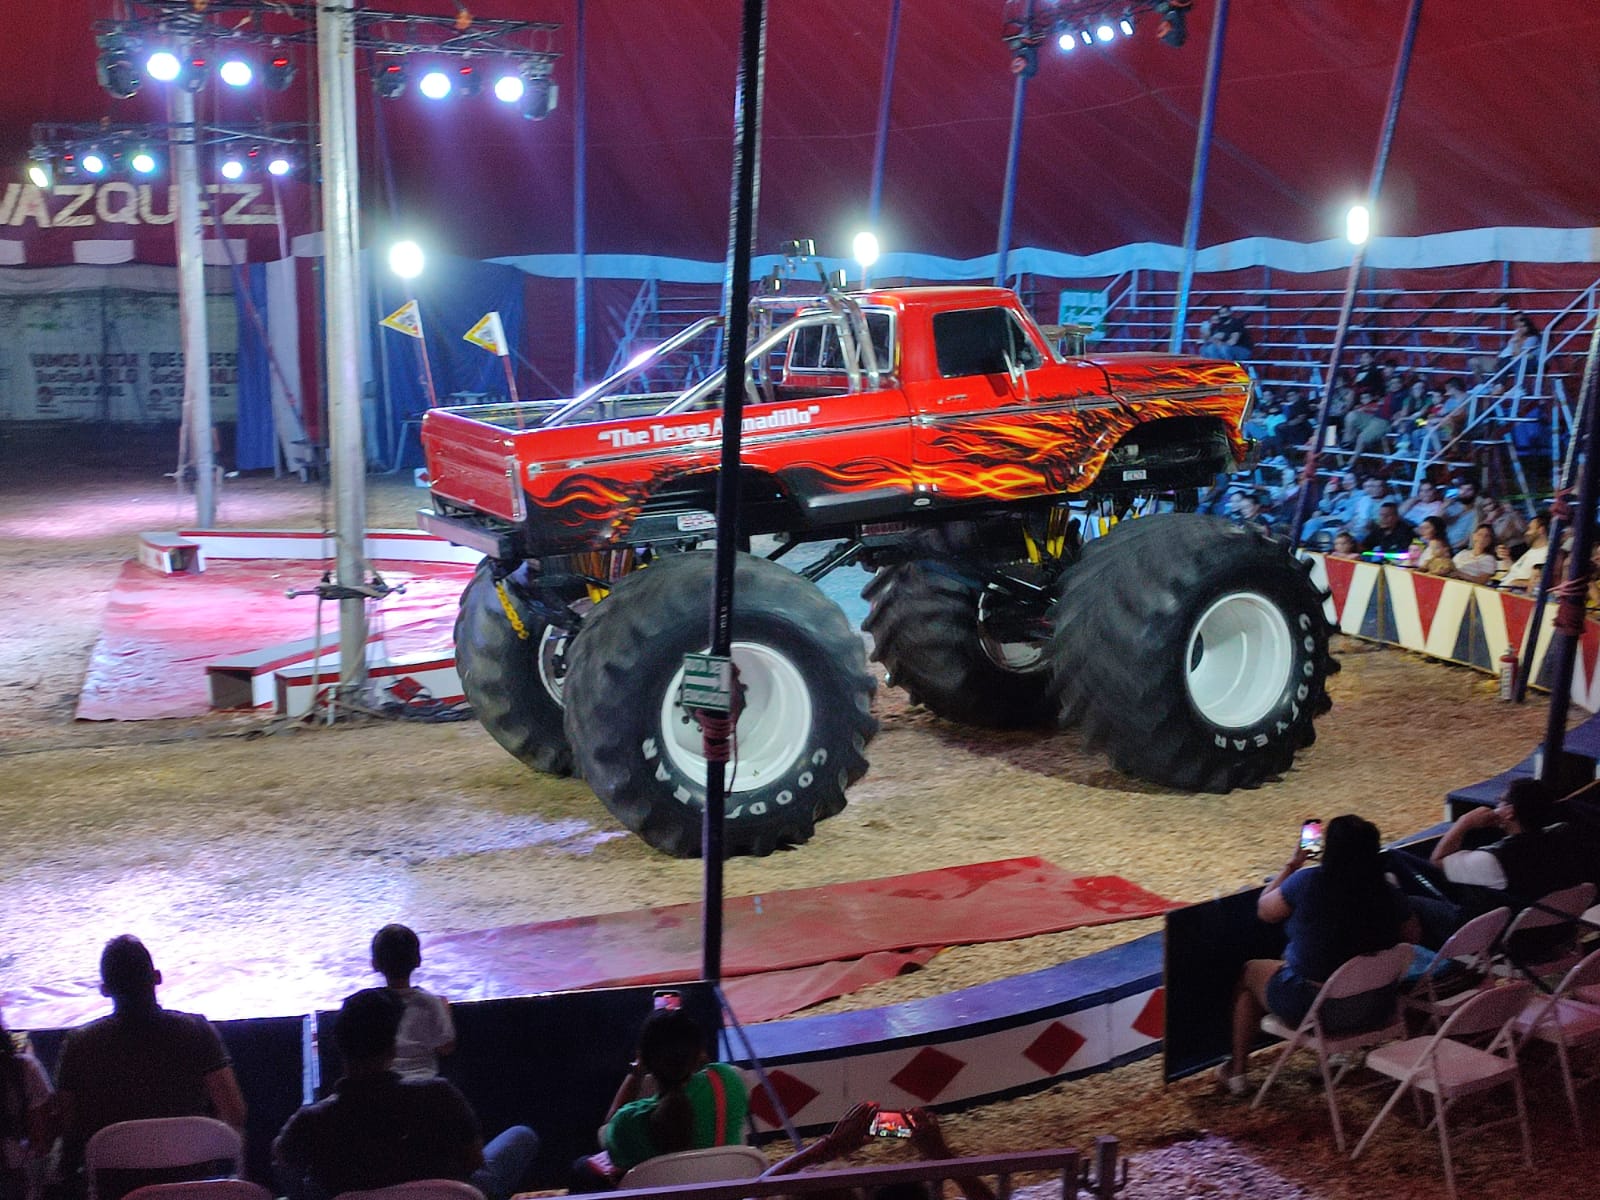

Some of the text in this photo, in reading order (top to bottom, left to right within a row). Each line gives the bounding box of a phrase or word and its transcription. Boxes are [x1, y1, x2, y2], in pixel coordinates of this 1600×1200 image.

[651, 423, 710, 442] Texas
[712, 405, 820, 436] Amadillo"
[642, 738, 828, 818] GOODEAR
